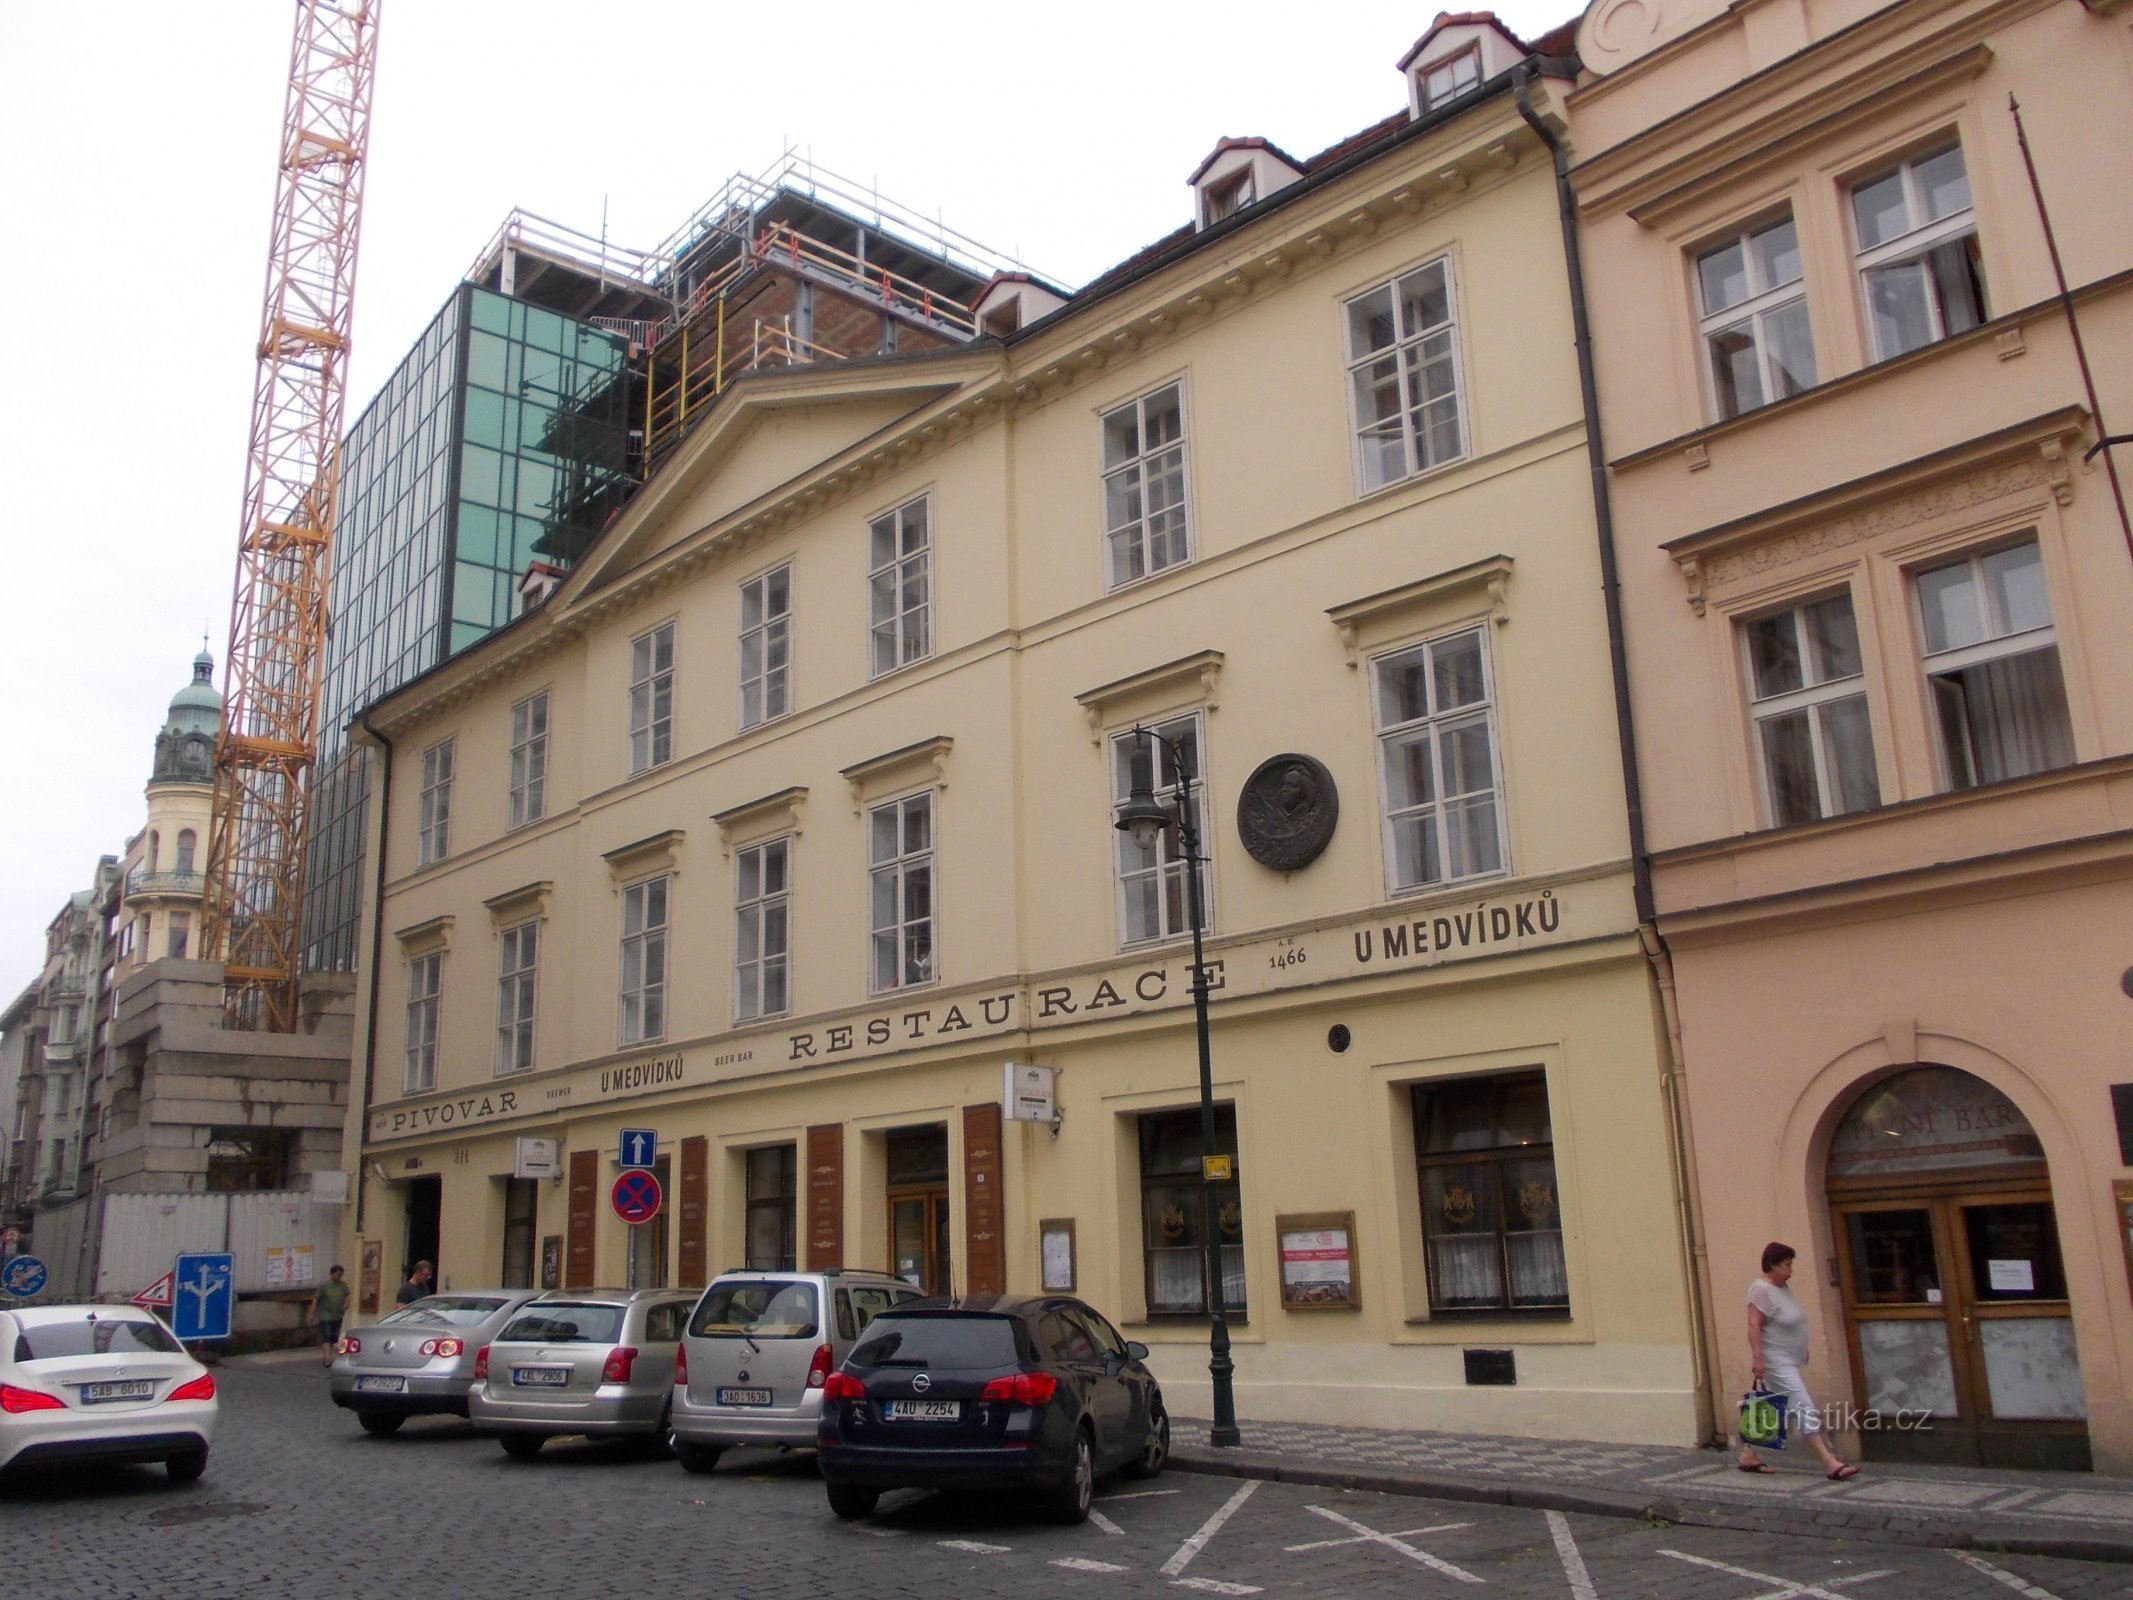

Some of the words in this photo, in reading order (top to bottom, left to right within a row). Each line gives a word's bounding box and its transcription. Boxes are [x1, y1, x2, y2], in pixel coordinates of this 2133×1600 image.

[1354, 930, 1373, 963] U
[1382, 889, 1560, 960] MEDVÍDKŮ
[1269, 947, 1307, 971] 1466
[714, 1054, 735, 1067] BEER
[737, 1051, 754, 1063] BAR
[601, 1071, 610, 1093] U
[612, 1052, 685, 1091] MEDVÍDKŮ
[391, 1090, 519, 1132] PIVOVAR
[90, 1384, 113, 1398] 5AB
[120, 1383, 149, 1396] 6010
[894, 1400, 917, 1416] 4AU
[924, 1402, 955, 1416] 2254
